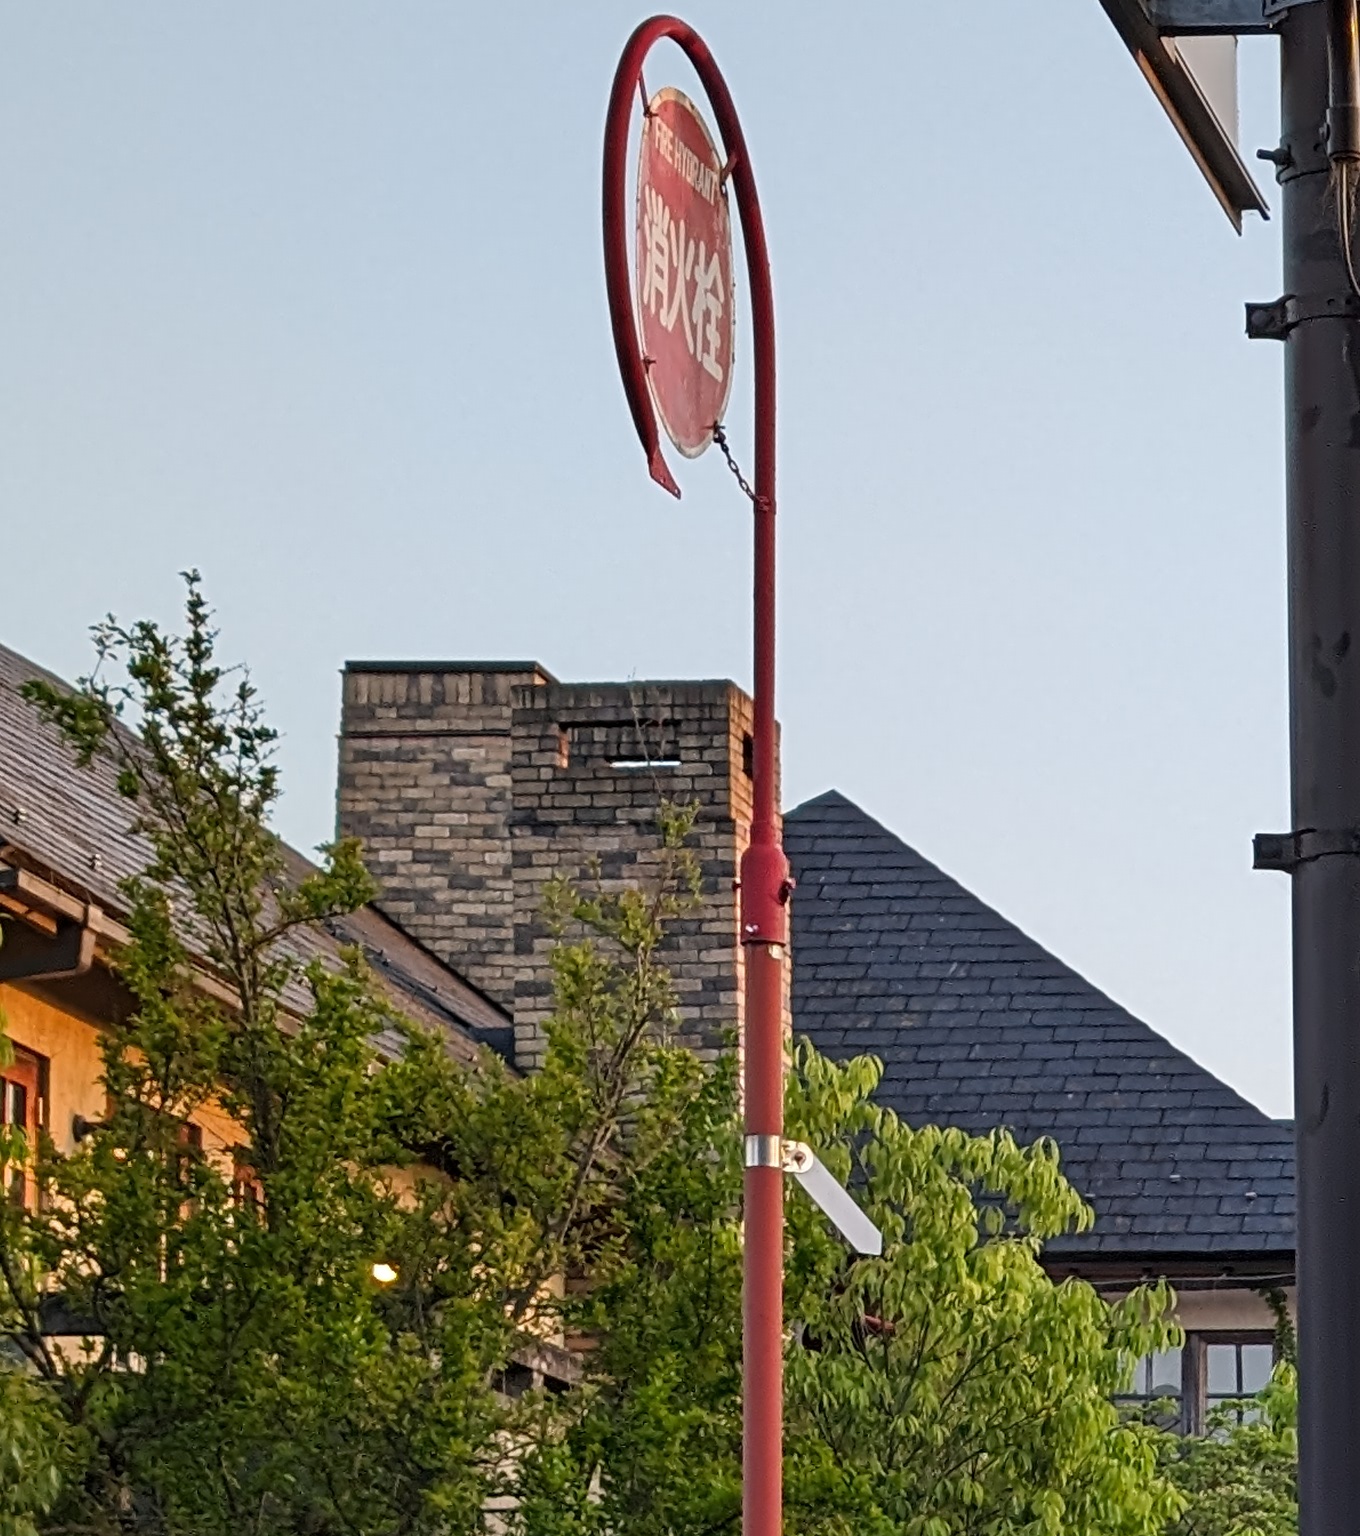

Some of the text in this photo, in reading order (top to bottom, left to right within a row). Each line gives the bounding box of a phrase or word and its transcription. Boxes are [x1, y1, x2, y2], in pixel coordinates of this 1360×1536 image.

[655, 116, 718, 206] FIRE HYDRANT
[643, 184, 724, 383] 消火栓
